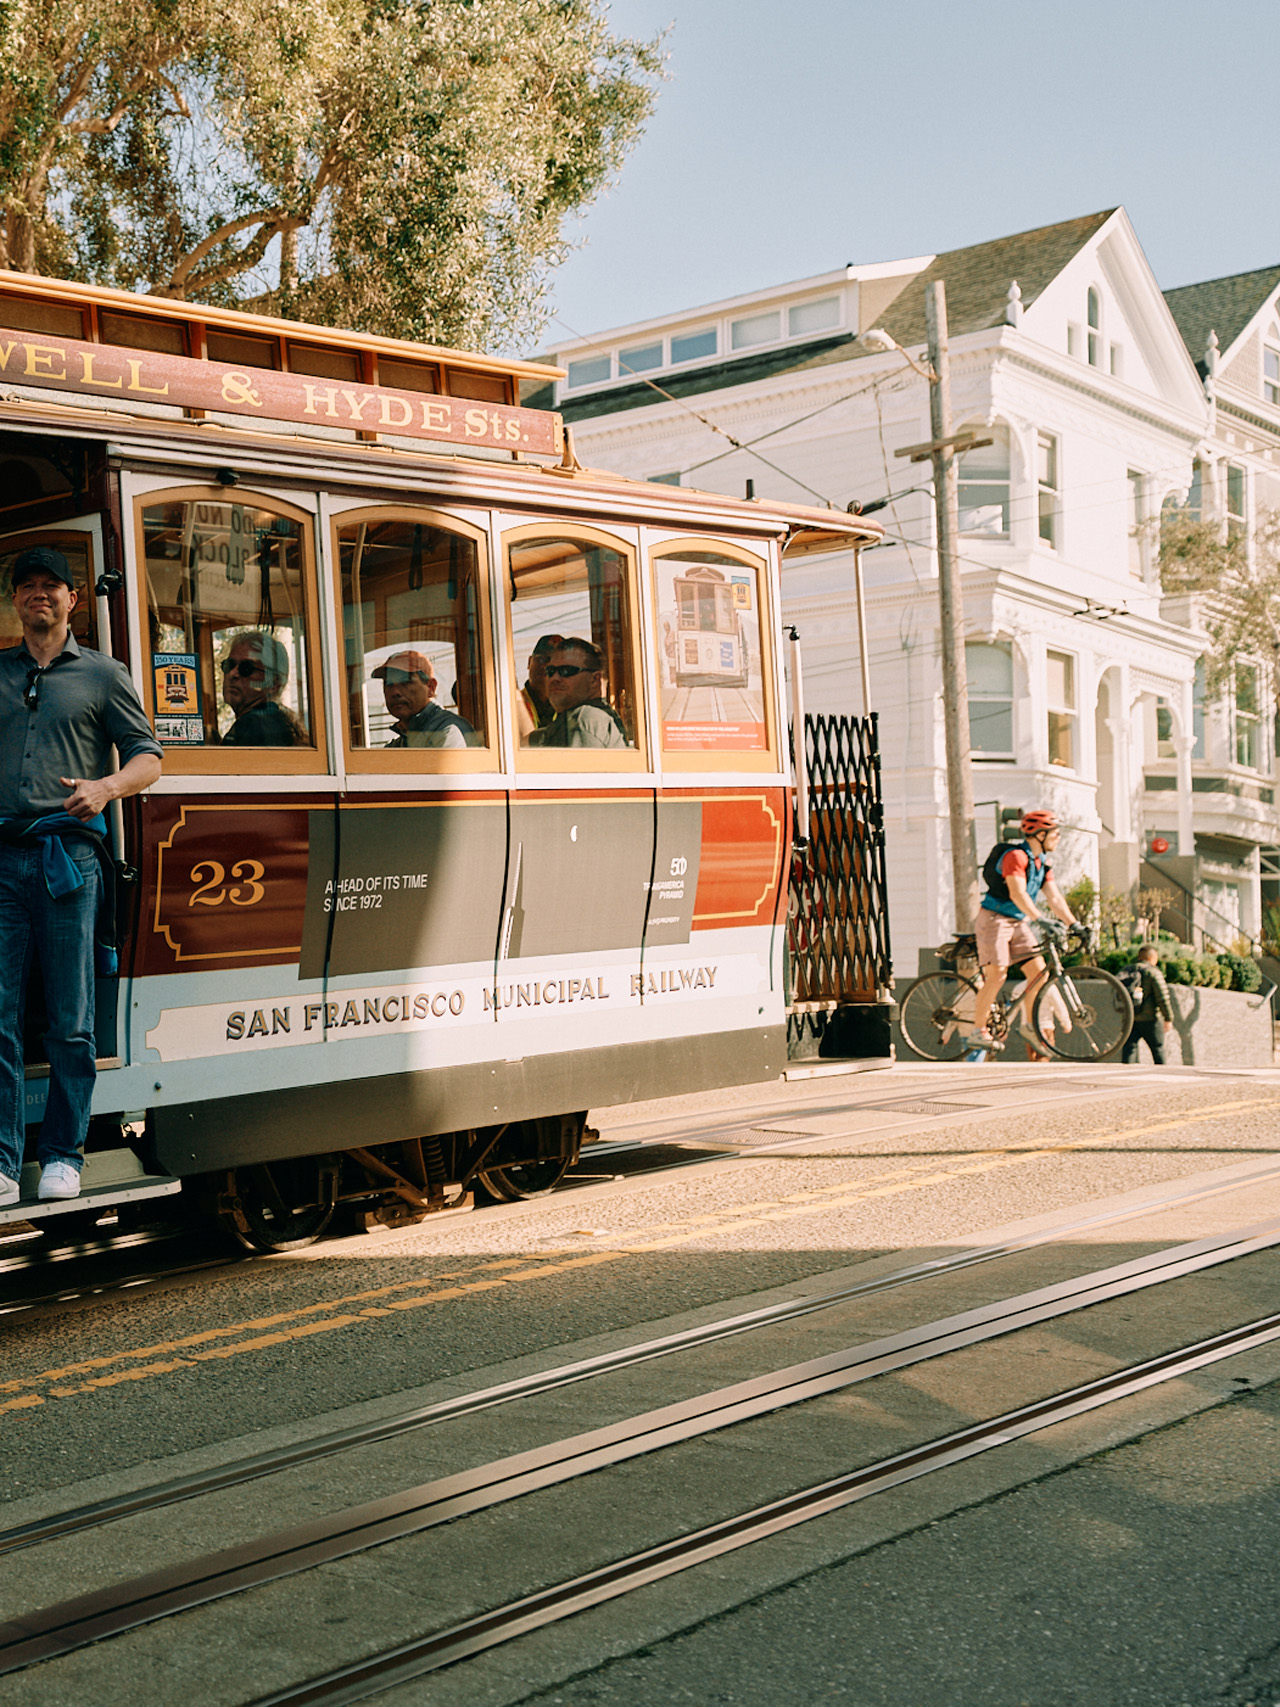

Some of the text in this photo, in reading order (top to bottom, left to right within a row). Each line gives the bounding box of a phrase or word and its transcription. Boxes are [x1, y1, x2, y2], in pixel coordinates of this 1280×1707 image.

[220, 371, 263, 408] &
[302, 383, 452, 433] HYDE
[464, 408, 530, 442] Sts.
[188, 859, 265, 907] 23
[670, 856, 687, 876] 50
[325, 874, 428, 894] AHEAD OF ITS TIME
[323, 894, 383, 912] SINCE 1972
[226, 966, 718, 1041] SAN FRANCISCO MUNICIPAL RAILWAY
